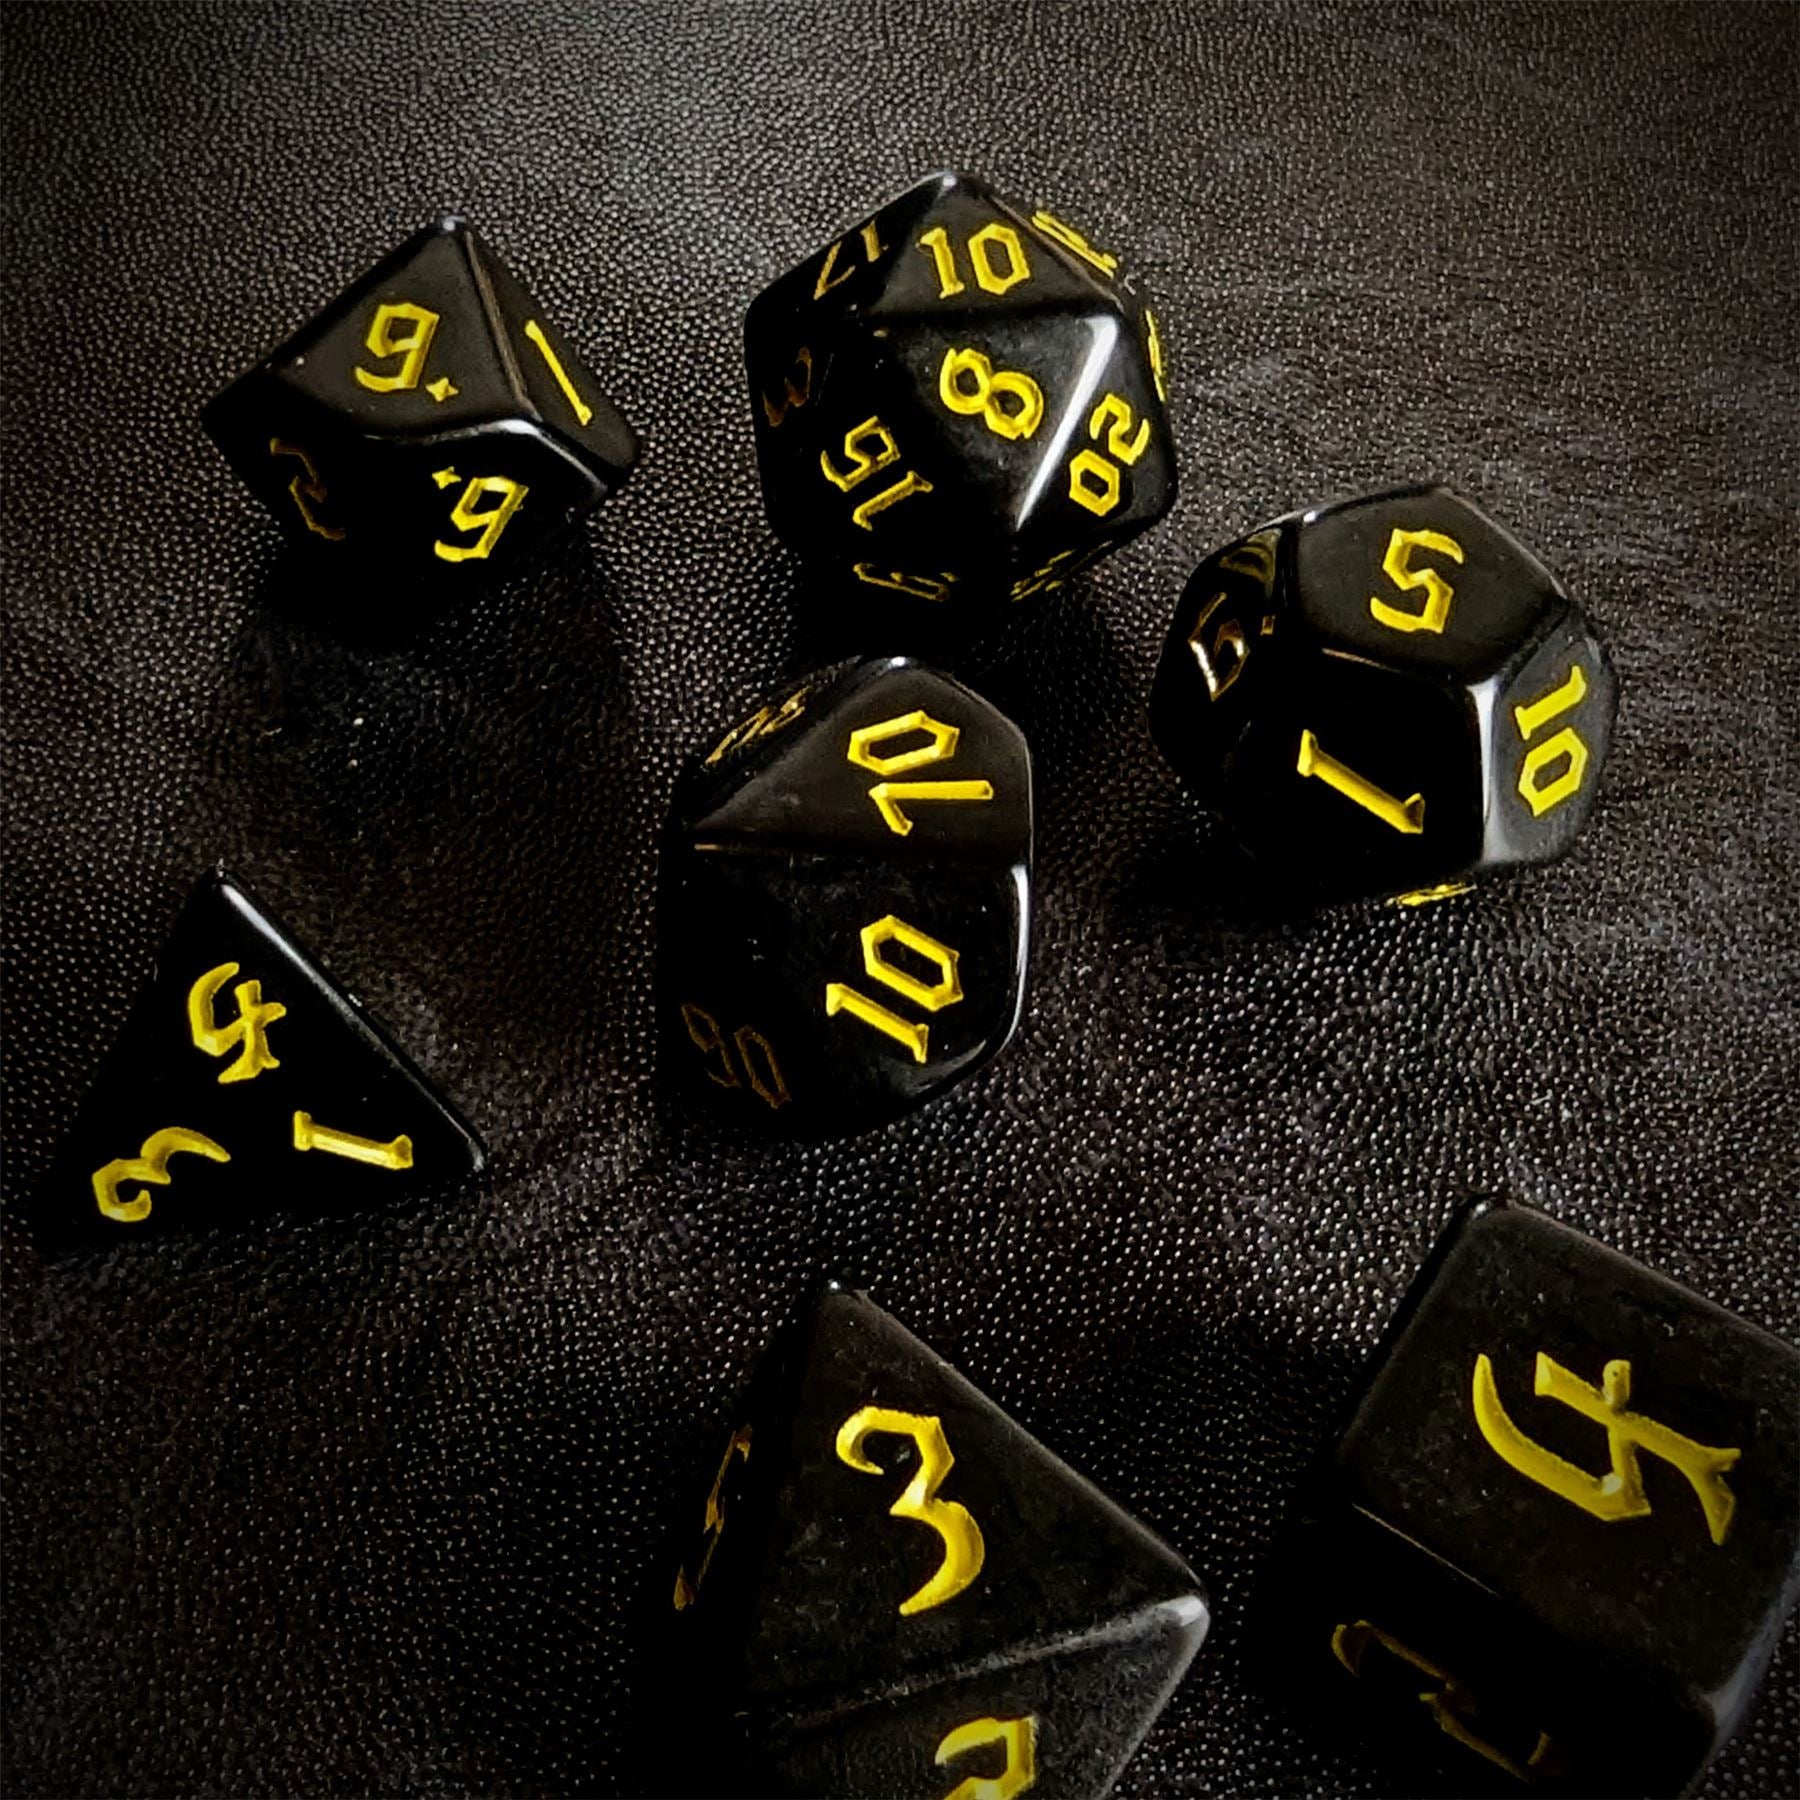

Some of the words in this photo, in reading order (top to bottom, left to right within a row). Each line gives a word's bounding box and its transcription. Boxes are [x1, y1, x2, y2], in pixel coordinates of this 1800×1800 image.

[915, 222, 1031, 300] 10
[524, 318, 594, 427] 1
[938, 346, 1045, 441] 8
[1068, 393, 1152, 517] 20
[1369, 527, 1465, 634] 5
[1296, 729, 1425, 834] 1
[1514, 665, 1589, 818] 10
[188, 961, 287, 1084] 4
[826, 915, 964, 1065] 10
[91, 1126, 231, 1223] 3
[293, 1110, 414, 1171] 1
[1472, 1351, 1742, 1545] 4
[835, 1405, 985, 1617] 3
